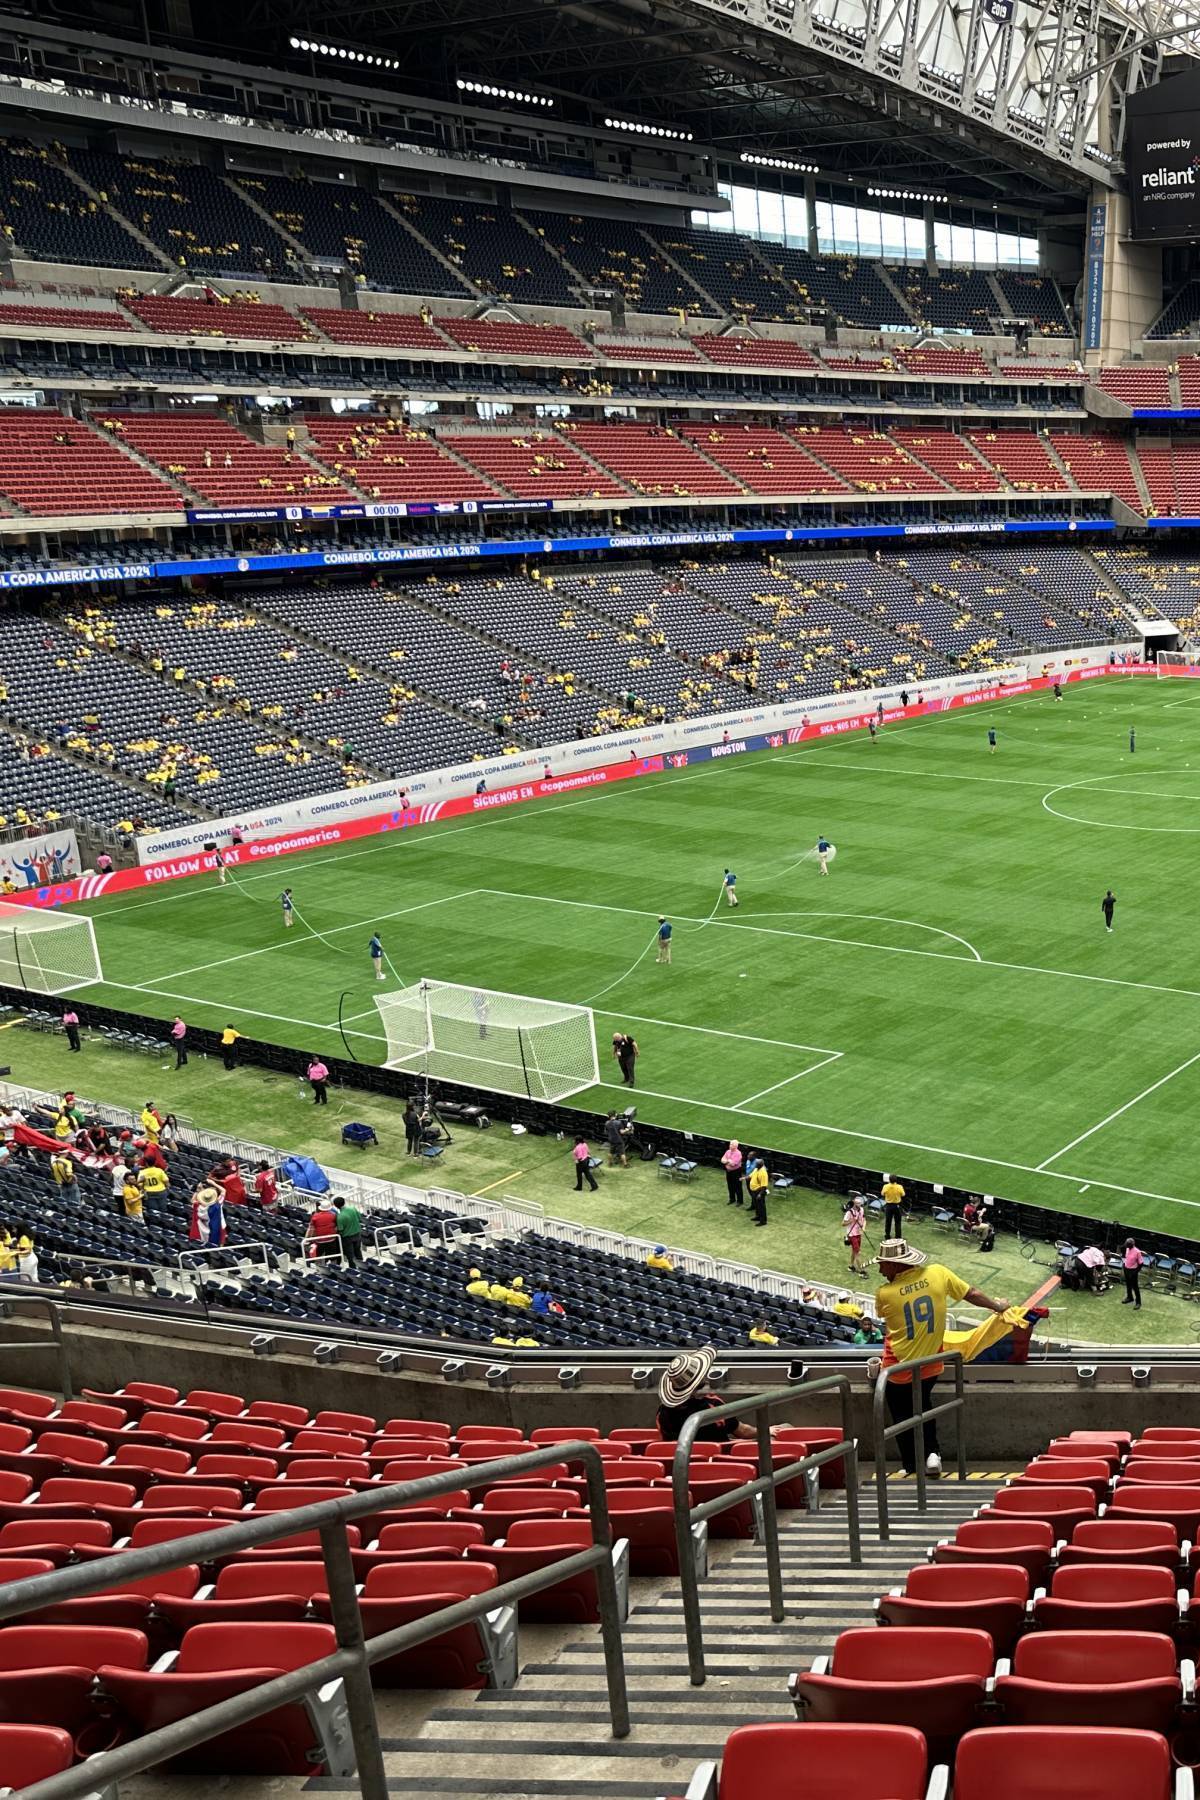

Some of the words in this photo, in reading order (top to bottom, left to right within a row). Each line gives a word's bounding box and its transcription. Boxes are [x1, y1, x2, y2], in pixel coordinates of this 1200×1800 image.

[991, 2, 1007, 18] 2019
[1147, 139, 1180, 152] powered
[1181, 139, 1191, 149] by
[1142, 166, 1195, 187] reliant
[1152, 192, 1166, 200] NRG
[1167, 192, 1195, 200] company
[291, 508, 298, 518] 0
[373, 505, 399, 515] 00:00
[467, 503, 473, 511] 0
[610, 537, 651, 547] CONMEBOL
[652, 536, 671, 544] COPA
[672, 535, 703, 543] AMERICA
[324, 551, 377, 564] CONMEBOL
[378, 550, 401, 561] COPA
[403, 548, 441, 559] AMERICA
[443, 547, 459, 557] USA
[460, 546, 480, 555] 2024
[10, 573, 45, 586] COPA
[46, 569, 98, 584] AMERICA
[100, 567, 122, 580] USA
[124, 565, 150, 578] 2024
[711, 741, 746, 757] HOUSTON
[451, 770, 484, 782] CONMEBOL
[484, 766, 500, 776] COPA
[501, 761, 526, 771] AMERICA
[521, 786, 533, 798] EN
[540, 772, 606, 791] @copaamerica
[311, 800, 350, 815] CONMEBOL
[349, 796, 367, 806] COPA
[368, 789, 397, 802] AMERICA
[411, 783, 426, 792] 2024
[147, 837, 190, 854] CONMEBOL
[193, 834, 214, 843] COPA
[250, 820, 264, 830] USA
[264, 817, 283, 826] 2024
[144, 858, 200, 882] FOLLOW
[225, 850, 240, 864] AT
[250, 829, 341, 856] @copaamerica
[903, 1295, 935, 1340] 19
